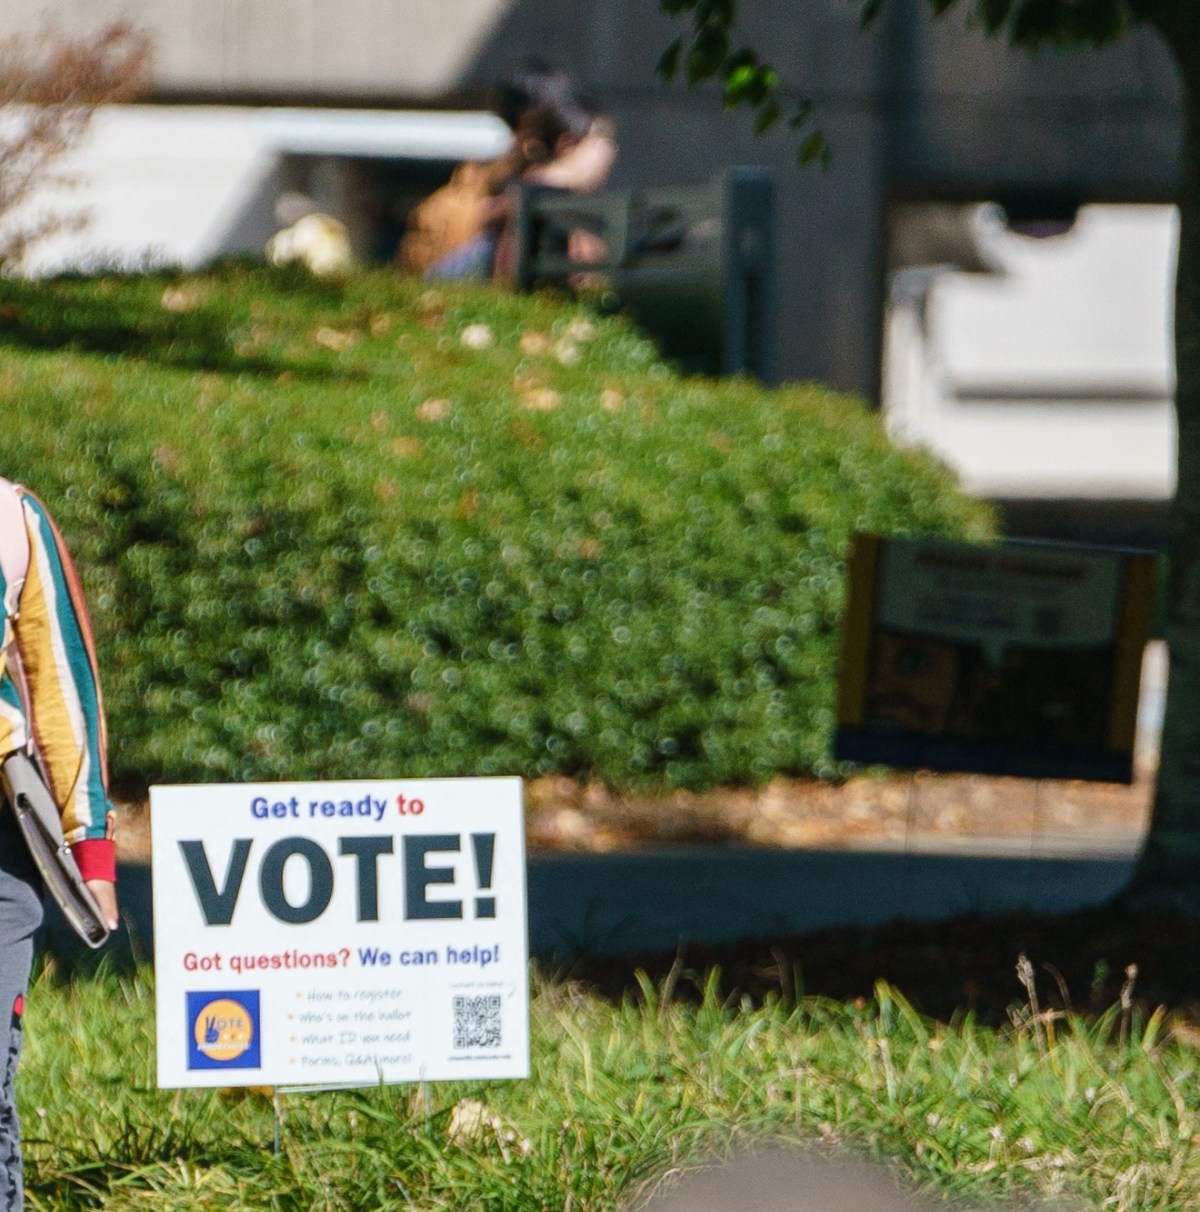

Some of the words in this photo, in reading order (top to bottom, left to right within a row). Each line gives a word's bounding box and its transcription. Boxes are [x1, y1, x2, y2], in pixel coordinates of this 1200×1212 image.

[251, 797, 299, 819] Get
[309, 794, 387, 821] ready
[397, 794, 424, 815] to
[177, 833, 496, 926] VOTE!
[183, 952, 222, 971] Got
[229, 949, 350, 974] questions?
[358, 948, 391, 967] We
[400, 948, 438, 965] can
[447, 945, 499, 968] help!
